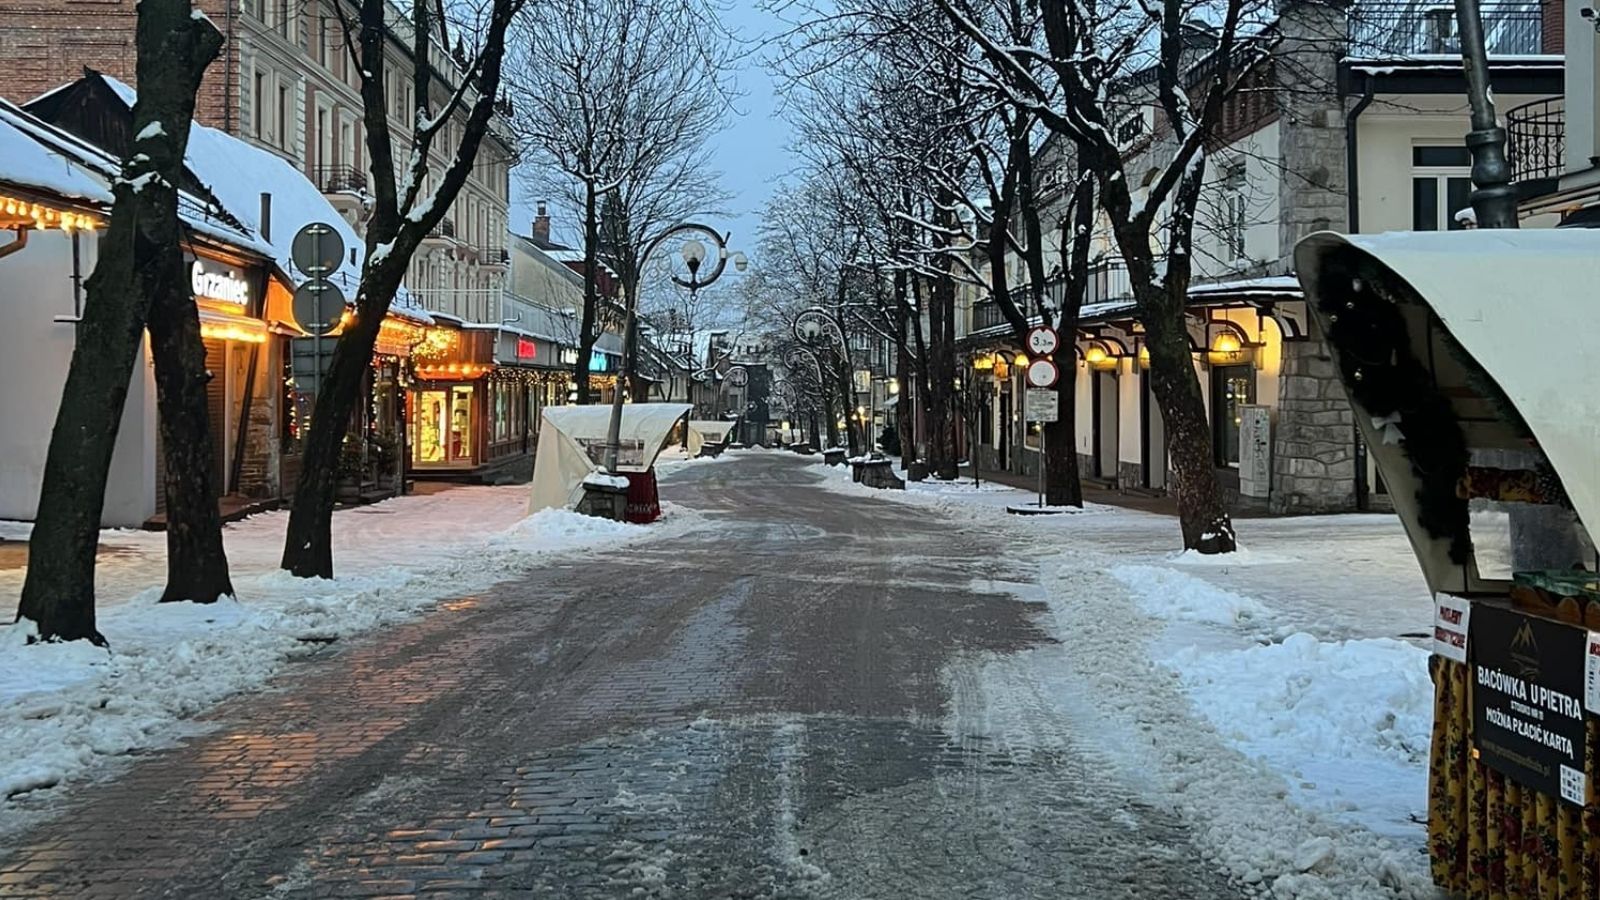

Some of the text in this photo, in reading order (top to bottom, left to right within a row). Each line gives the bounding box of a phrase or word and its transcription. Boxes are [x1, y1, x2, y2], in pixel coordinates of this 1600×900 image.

[191, 260, 248, 305] Grzaniec
[1477, 665, 1582, 721] BACÓWKA U PIETRA
[1485, 706, 1512, 731] MOŻNA
[1513, 718, 1543, 743] PŁACIĆ
[1543, 729, 1574, 760] KARTĄ
